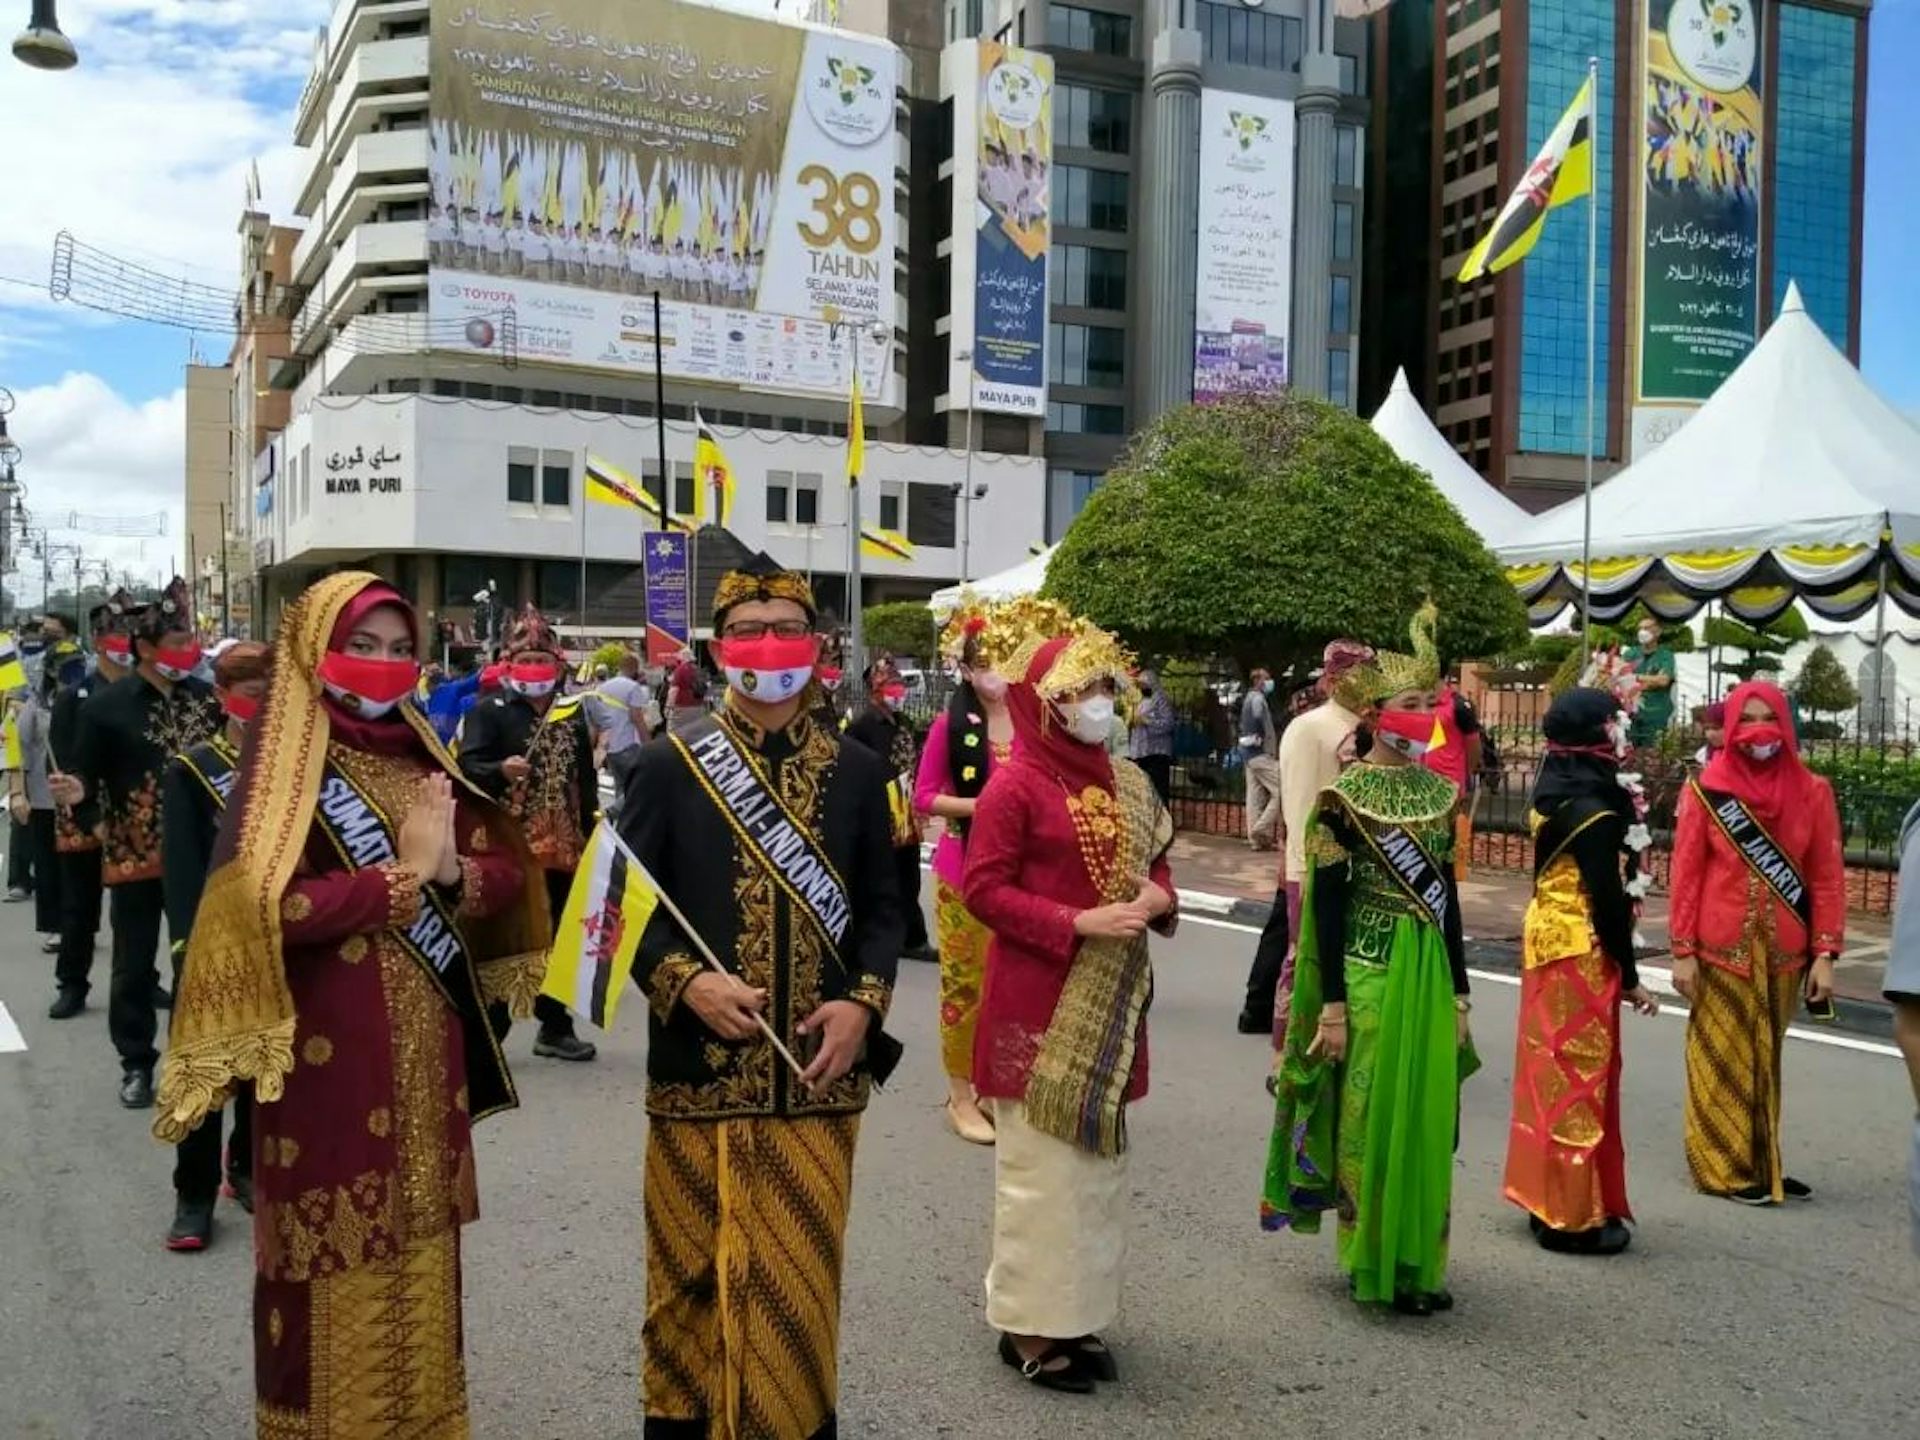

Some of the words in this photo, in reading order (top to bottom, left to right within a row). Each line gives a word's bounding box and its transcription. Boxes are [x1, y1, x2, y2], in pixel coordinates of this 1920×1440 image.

[470, 72, 542, 97] SAMBUTAN
[797, 163, 881, 255] 38
[807, 249, 880, 283] TAHUN
[462, 285, 516, 303] TOYOTA
[805, 276, 853, 293] SELAMAT
[979, 389, 1011, 404] MAYA
[1012, 393, 1037, 408] PURI
[325, 477, 361, 494] MAYA
[368, 477, 401, 494] PURI
[689, 728, 852, 946] PERMAI-INDONESIA
[1374, 826, 1428, 885] JAWA
[1716, 798, 1750, 834] DKI
[1740, 835, 1804, 906] JAKARTA
